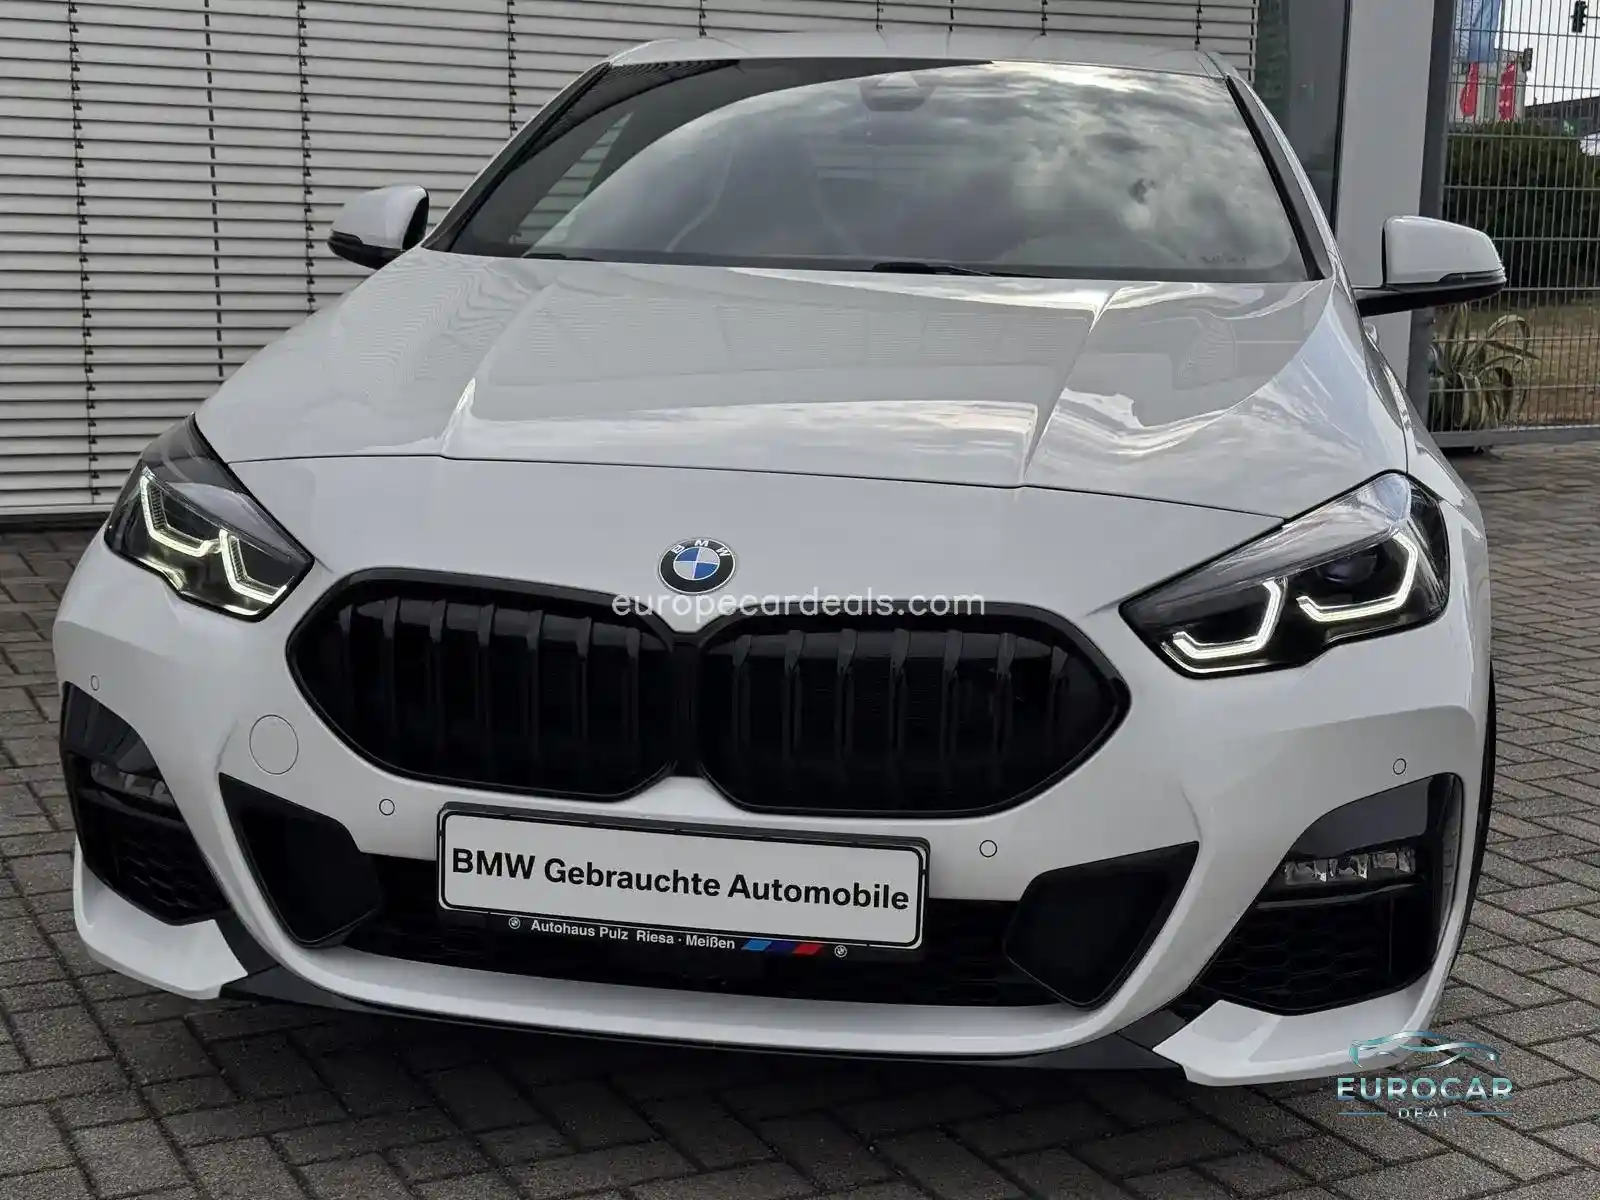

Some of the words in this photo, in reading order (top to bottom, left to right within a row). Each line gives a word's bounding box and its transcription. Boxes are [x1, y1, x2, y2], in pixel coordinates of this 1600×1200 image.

[672, 538, 731, 558] BMW
[452, 847, 536, 880] BMW
[544, 857, 721, 897] Gebrauchte
[727, 873, 909, 910] Automobile
[530, 919, 596, 937] Autohaus
[599, 927, 629, 941] Pulz
[636, 930, 675, 945] Riesa
[685, 934, 736, 950] Meißen
